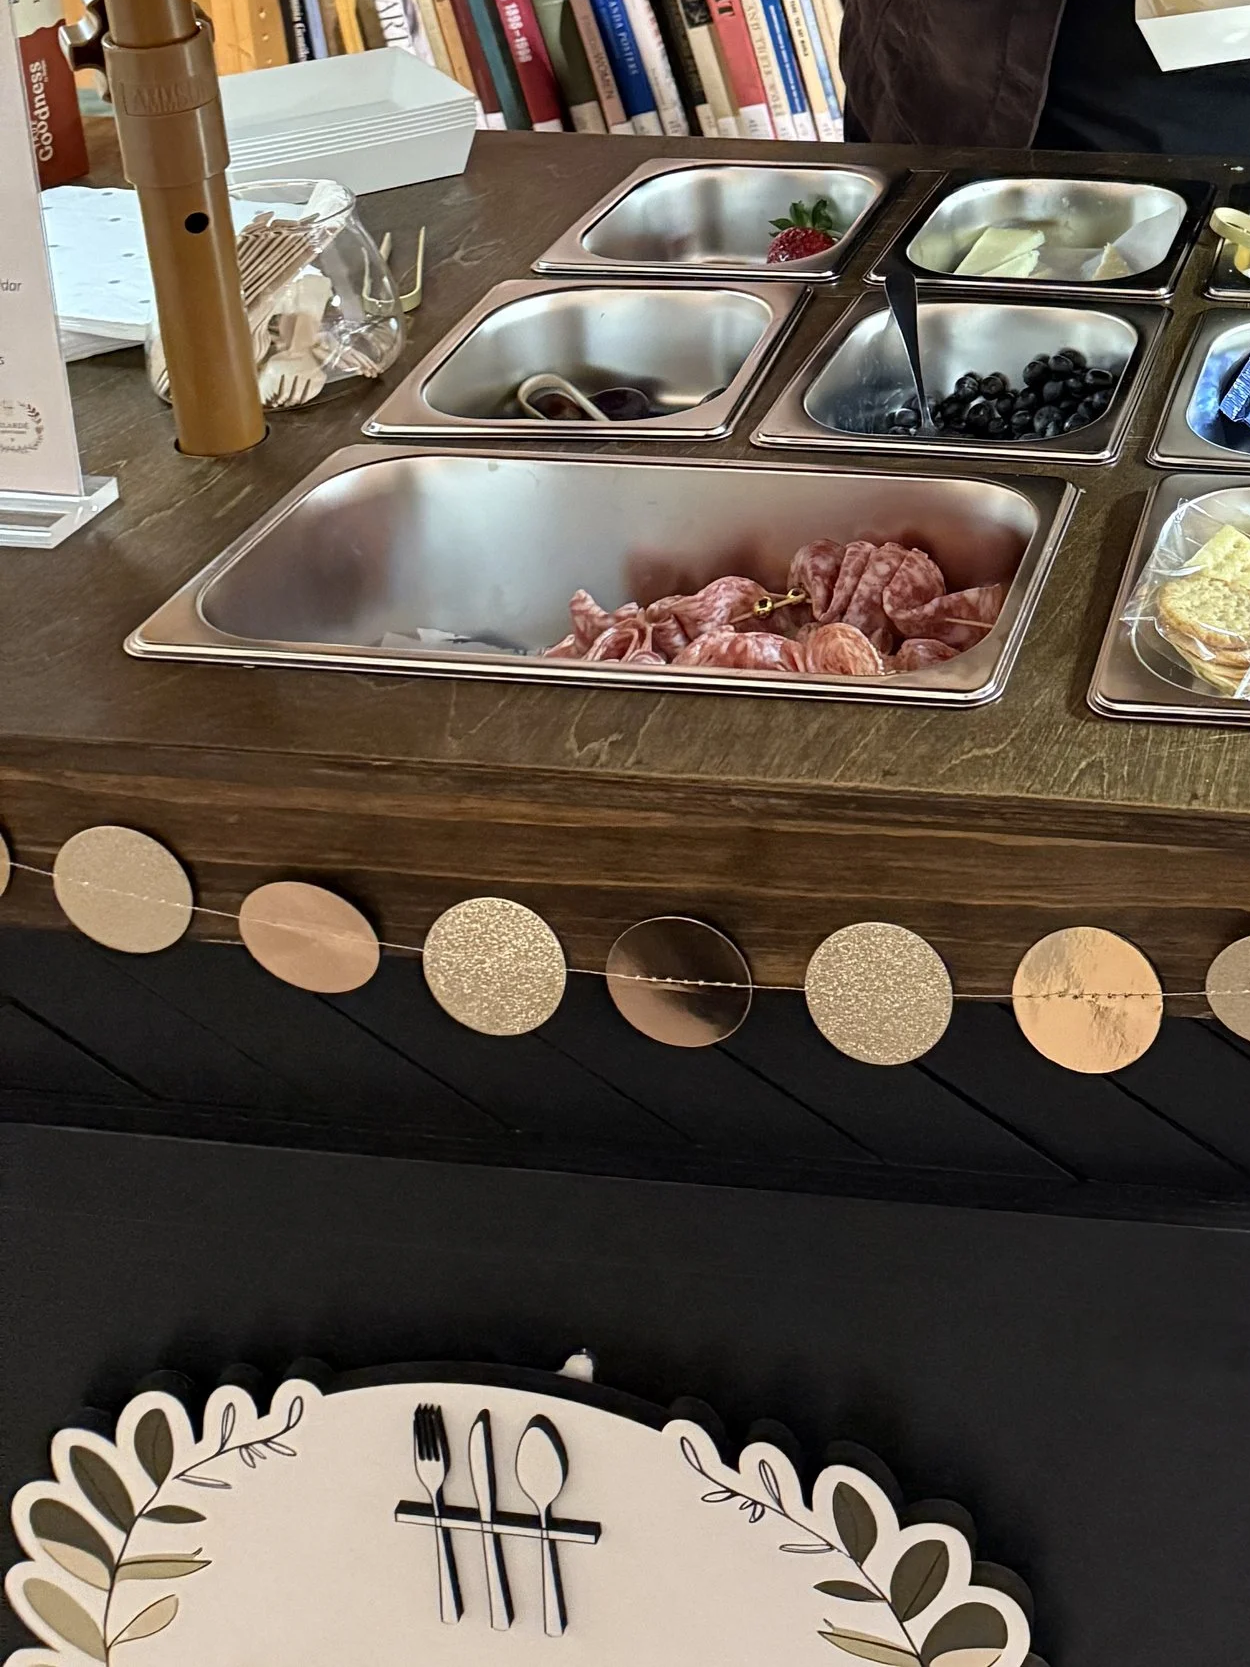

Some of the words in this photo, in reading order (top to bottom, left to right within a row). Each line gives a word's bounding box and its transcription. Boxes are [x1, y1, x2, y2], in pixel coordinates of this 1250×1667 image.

[617, 32, 640, 77] POSTERS
[746, 4, 761, 34] AND
[754, 36, 774, 77] THEIR
[593, 53, 616, 100] WOMEN
[28, 59, 54, 163] Goodness
[0, 279, 23, 293] dar
